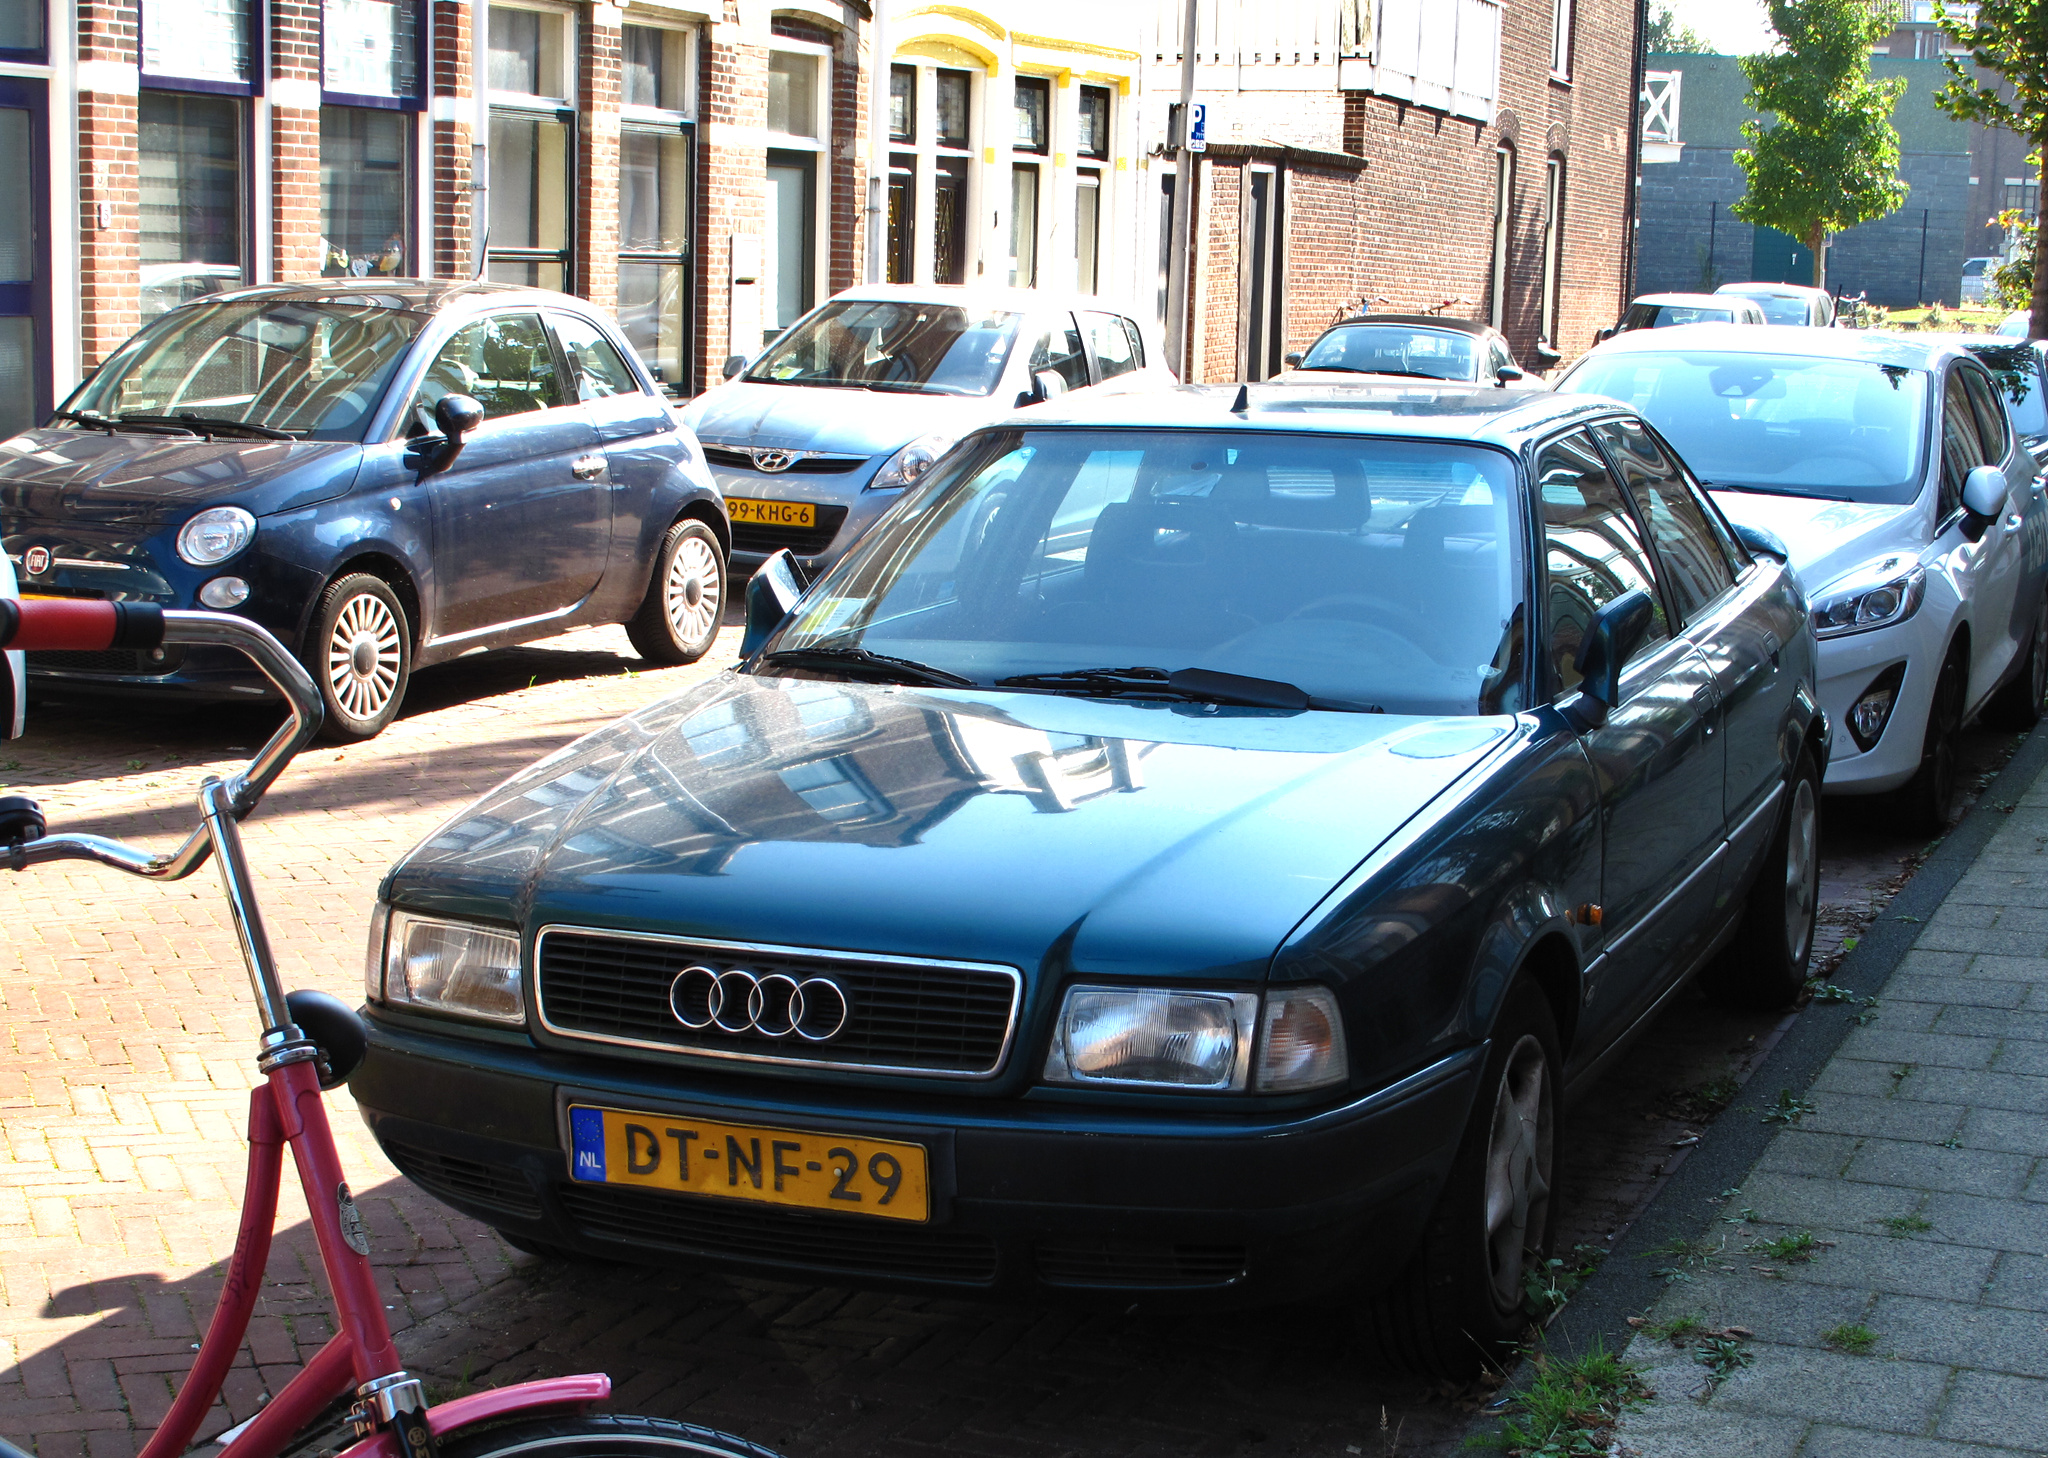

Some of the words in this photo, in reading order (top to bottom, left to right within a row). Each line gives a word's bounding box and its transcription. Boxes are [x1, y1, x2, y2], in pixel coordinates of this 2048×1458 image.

[1192, 105, 1202, 132] P
[728, 501, 810, 523] 99-KHG-6
[30, 554, 46, 567] FIAT
[579, 1151, 602, 1169] NL
[624, 1122, 902, 1206] DT-NF-29
